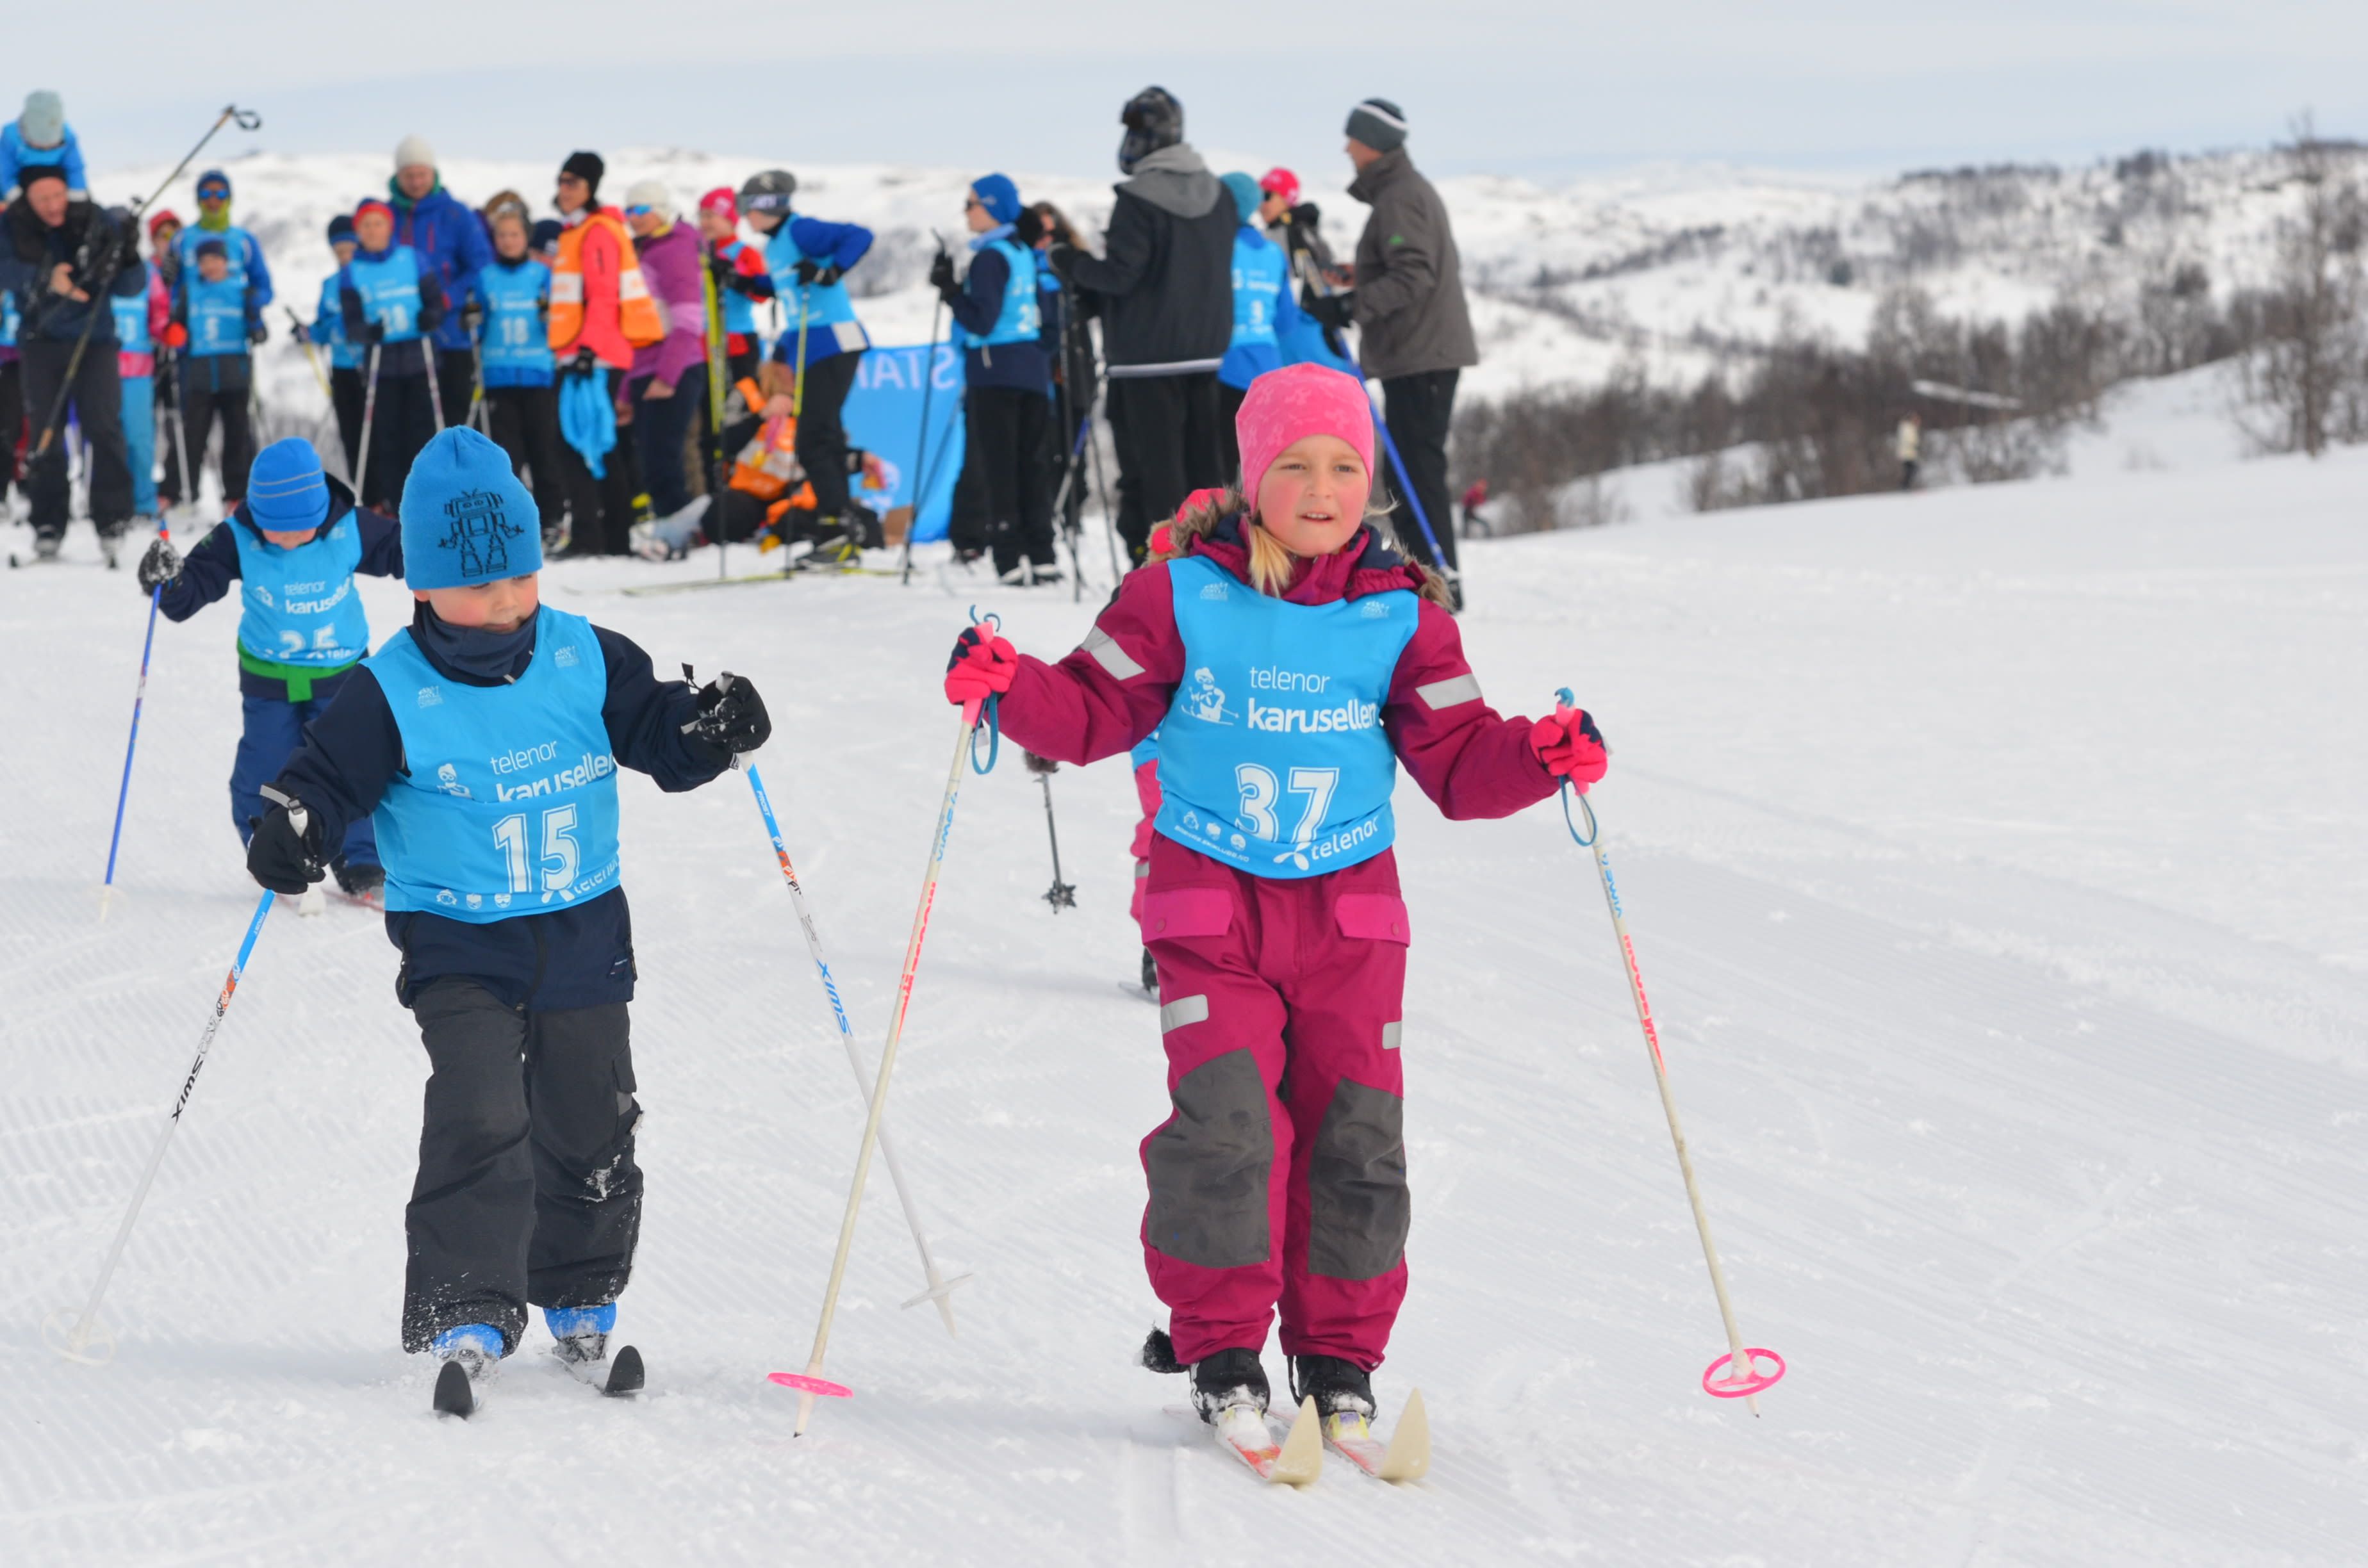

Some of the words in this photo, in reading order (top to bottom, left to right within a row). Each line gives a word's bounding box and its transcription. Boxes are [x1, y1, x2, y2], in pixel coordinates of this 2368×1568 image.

[284, 581, 325, 595] telenor
[1250, 666, 1331, 694] telenor
[1247, 698, 1377, 733] karusellen
[489, 740, 557, 775] telenor
[1235, 763, 1340, 844] 37
[491, 803, 580, 894] 15
[1311, 816, 1379, 860] telenor
